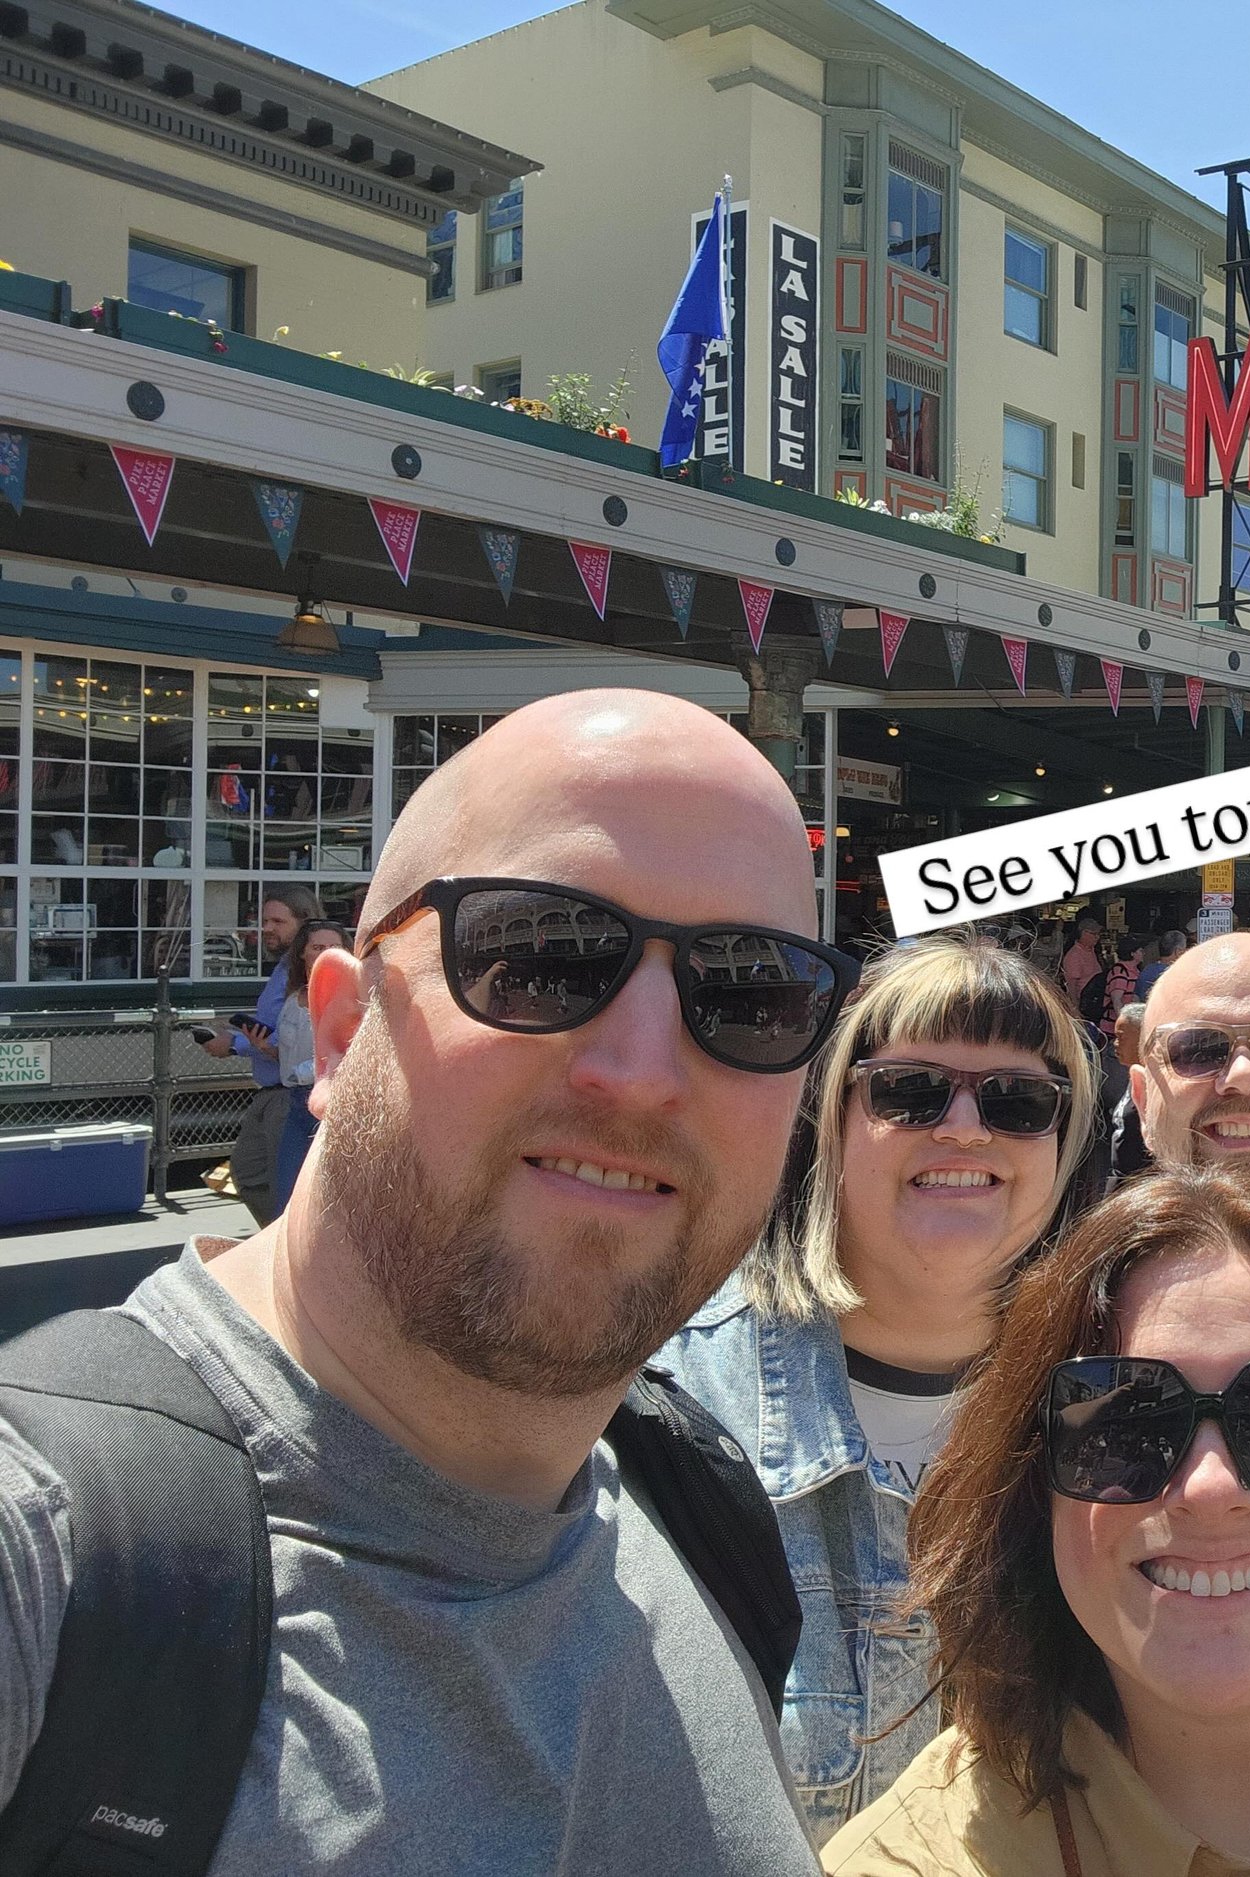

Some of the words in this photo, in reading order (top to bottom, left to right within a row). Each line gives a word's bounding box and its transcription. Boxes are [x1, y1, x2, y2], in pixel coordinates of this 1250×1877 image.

[780, 233, 810, 302] LA
[778, 314, 808, 471] SALLE
[129, 460, 145, 485] PIKE
[138, 461, 157, 495] PLACE
[146, 463, 168, 505] MARKET
[384, 512, 396, 534] PIKE
[390, 513, 405, 543] PLACE
[397, 515, 414, 552] MARKET
[0, 1044, 24, 1055] NO
[90, 1805, 165, 1837] pacsafe
